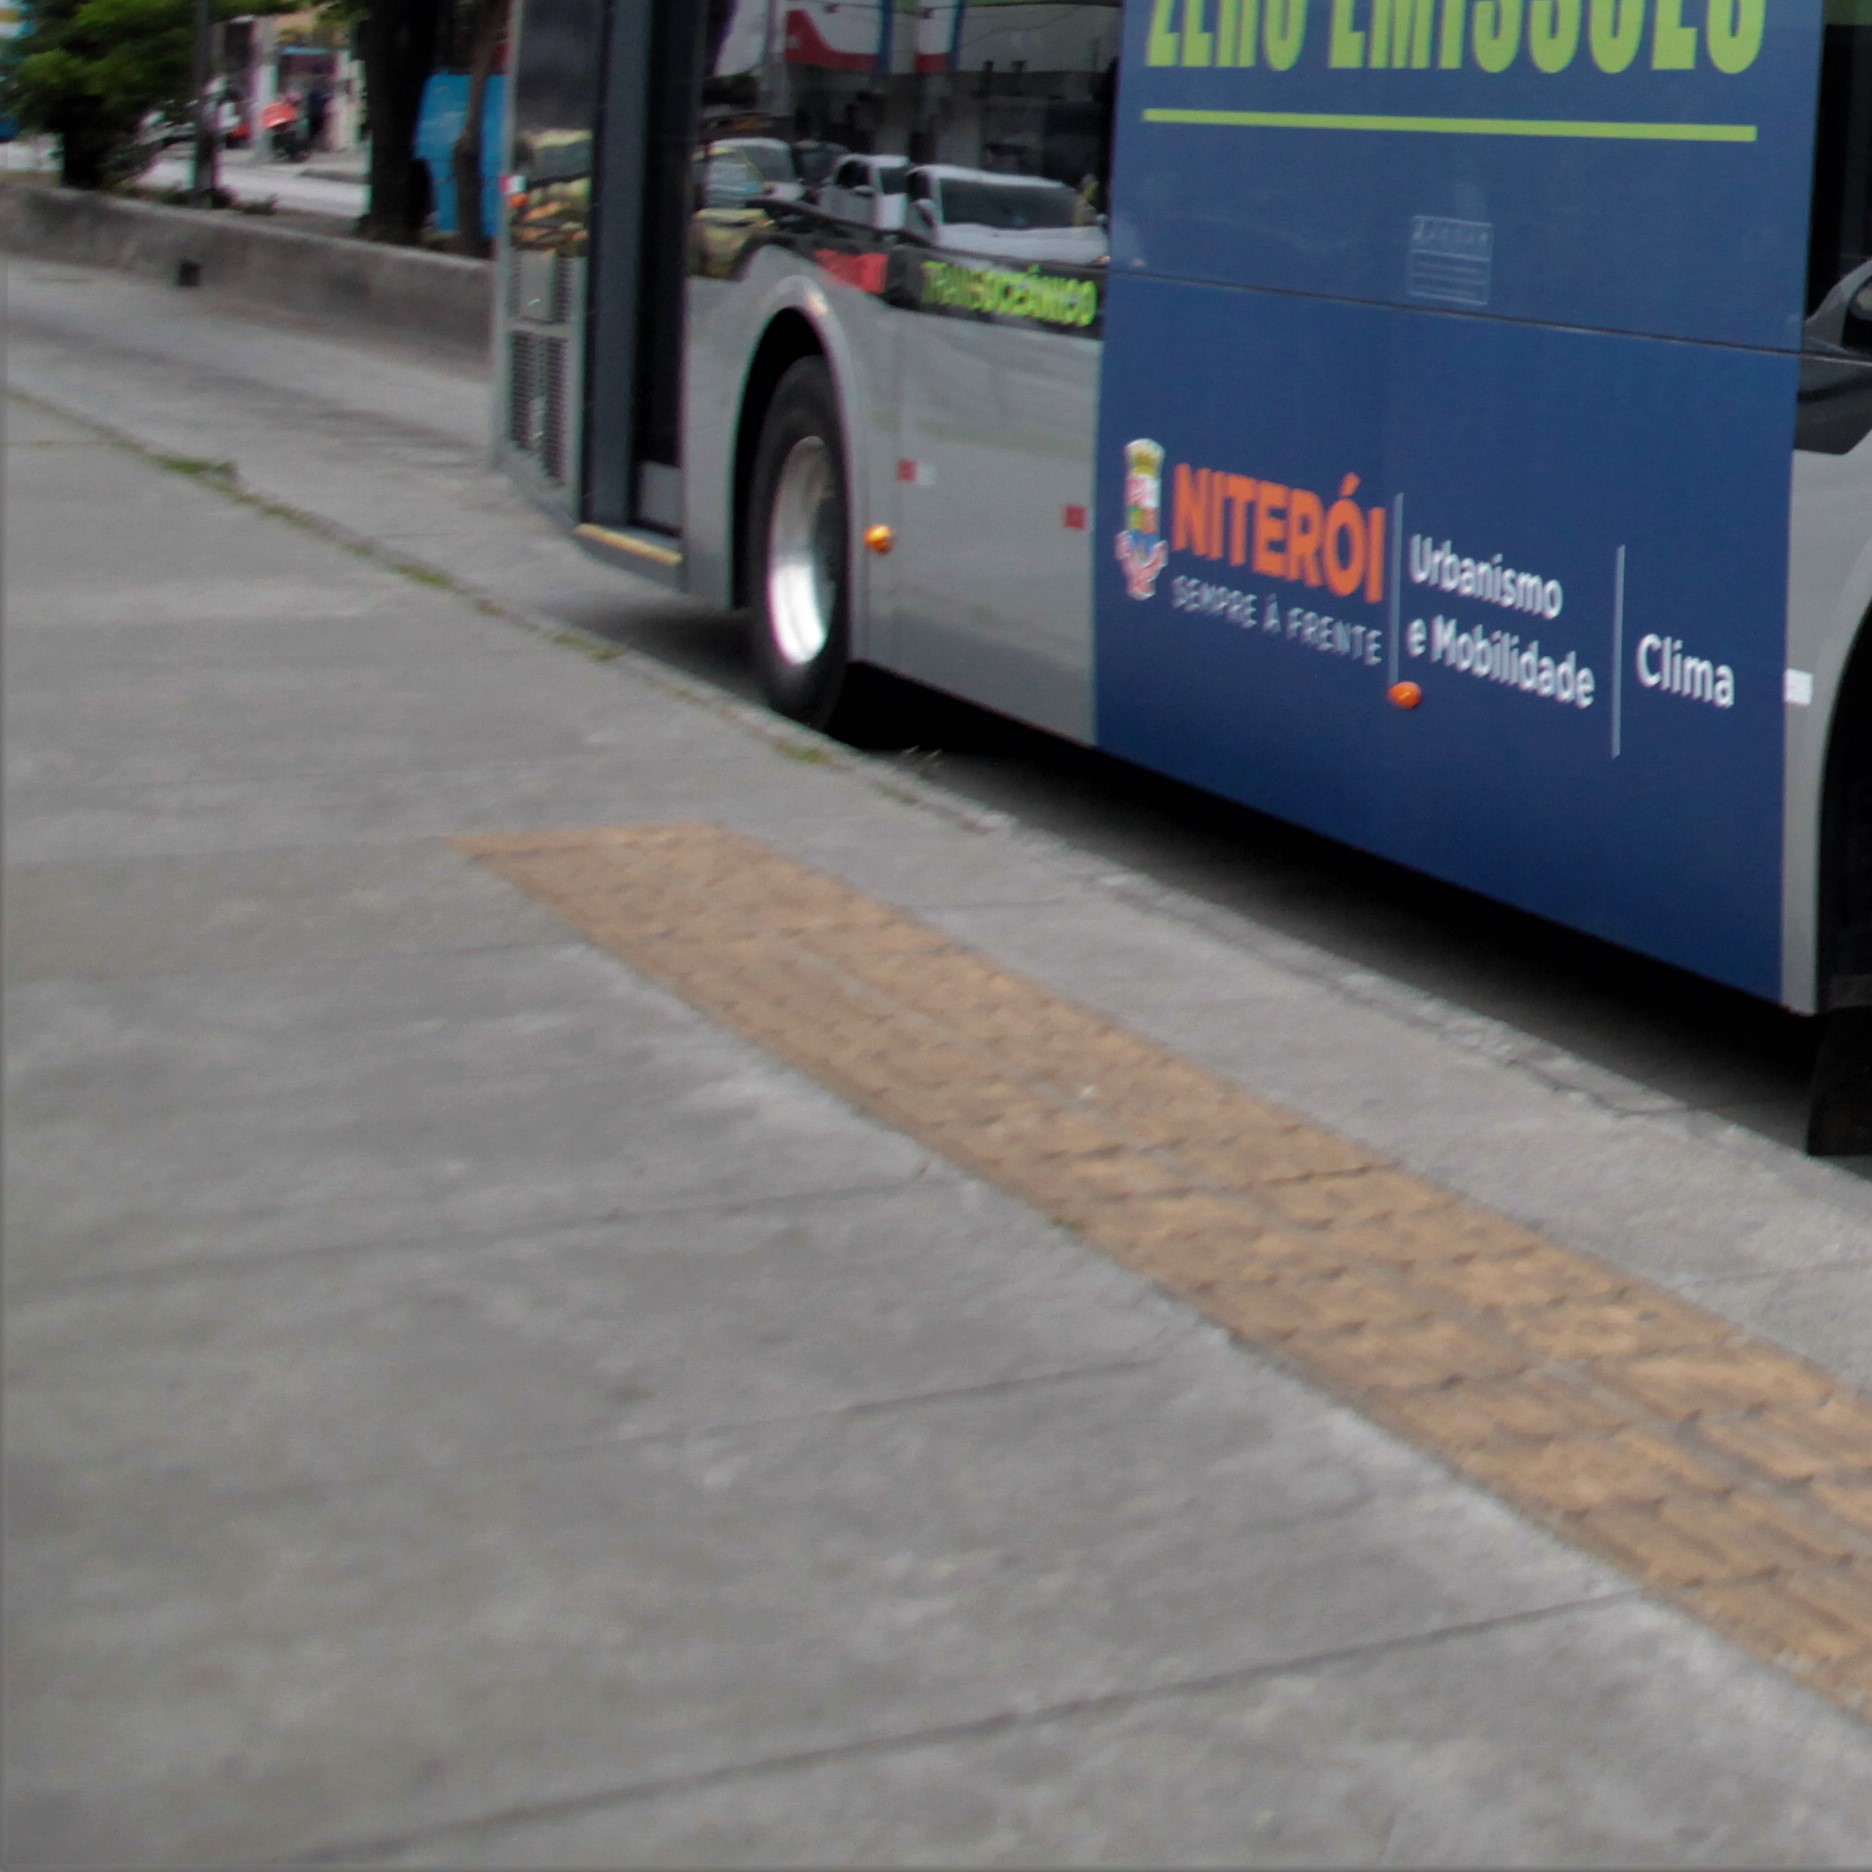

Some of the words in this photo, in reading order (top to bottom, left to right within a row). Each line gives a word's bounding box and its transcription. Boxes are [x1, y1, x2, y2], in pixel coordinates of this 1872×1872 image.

[1171, 461, 1387, 603] NITERÓI
[1408, 534, 1563, 619] Urbanismo
[1171, 574, 1258, 629] SEMPRE
[1287, 605, 1382, 666] FRENTE
[1406, 621, 1427, 657] e
[1430, 616, 1595, 709] Mobilidade
[1635, 632, 1736, 709] Clima
